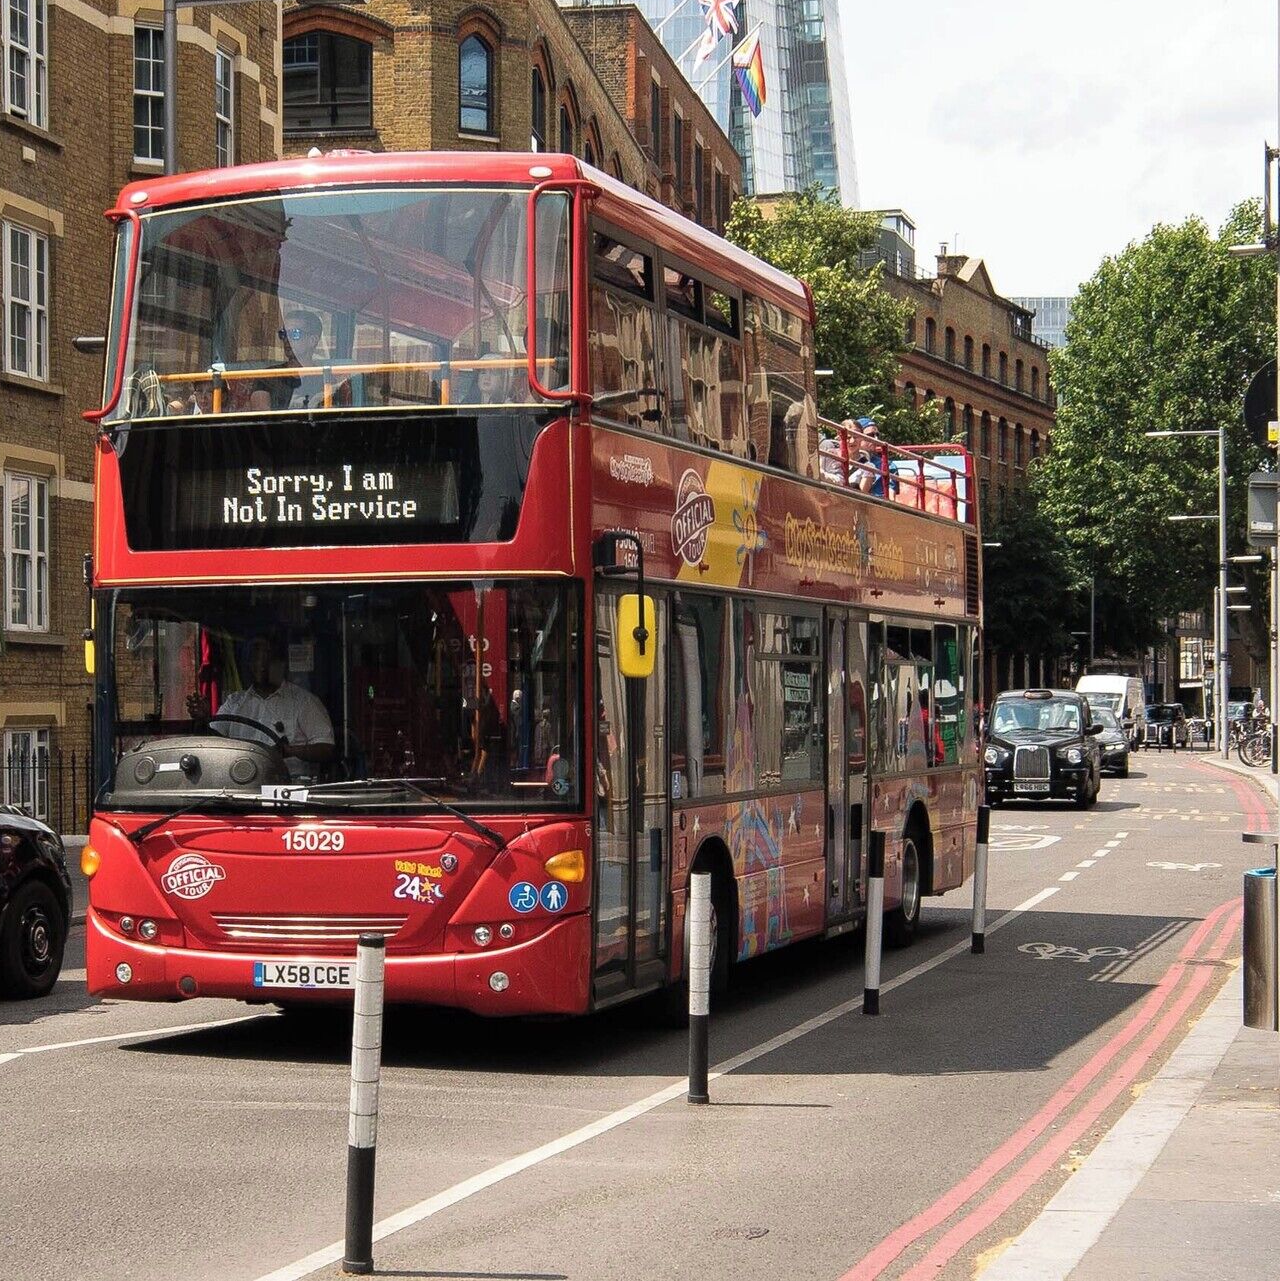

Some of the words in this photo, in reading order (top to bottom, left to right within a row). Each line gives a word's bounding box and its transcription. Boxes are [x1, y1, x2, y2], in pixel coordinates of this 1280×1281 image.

[247, 468, 333, 494] Sorry,
[343, 465, 352, 491] I
[363, 472, 394, 490] am
[223, 496, 267, 523] Not
[277, 496, 302, 522] In
[312, 495, 417, 521] Service
[675, 500, 714, 545] OFFICIAL
[689, 535, 706, 558] TOUR
[281, 831, 345, 851] 15029
[167, 867, 221, 889] OFFICIAL
[185, 882, 209, 896] TOUR
[394, 874, 420, 900] 24
[264, 964, 310, 984] LX58
[314, 966, 350, 985] CGE
